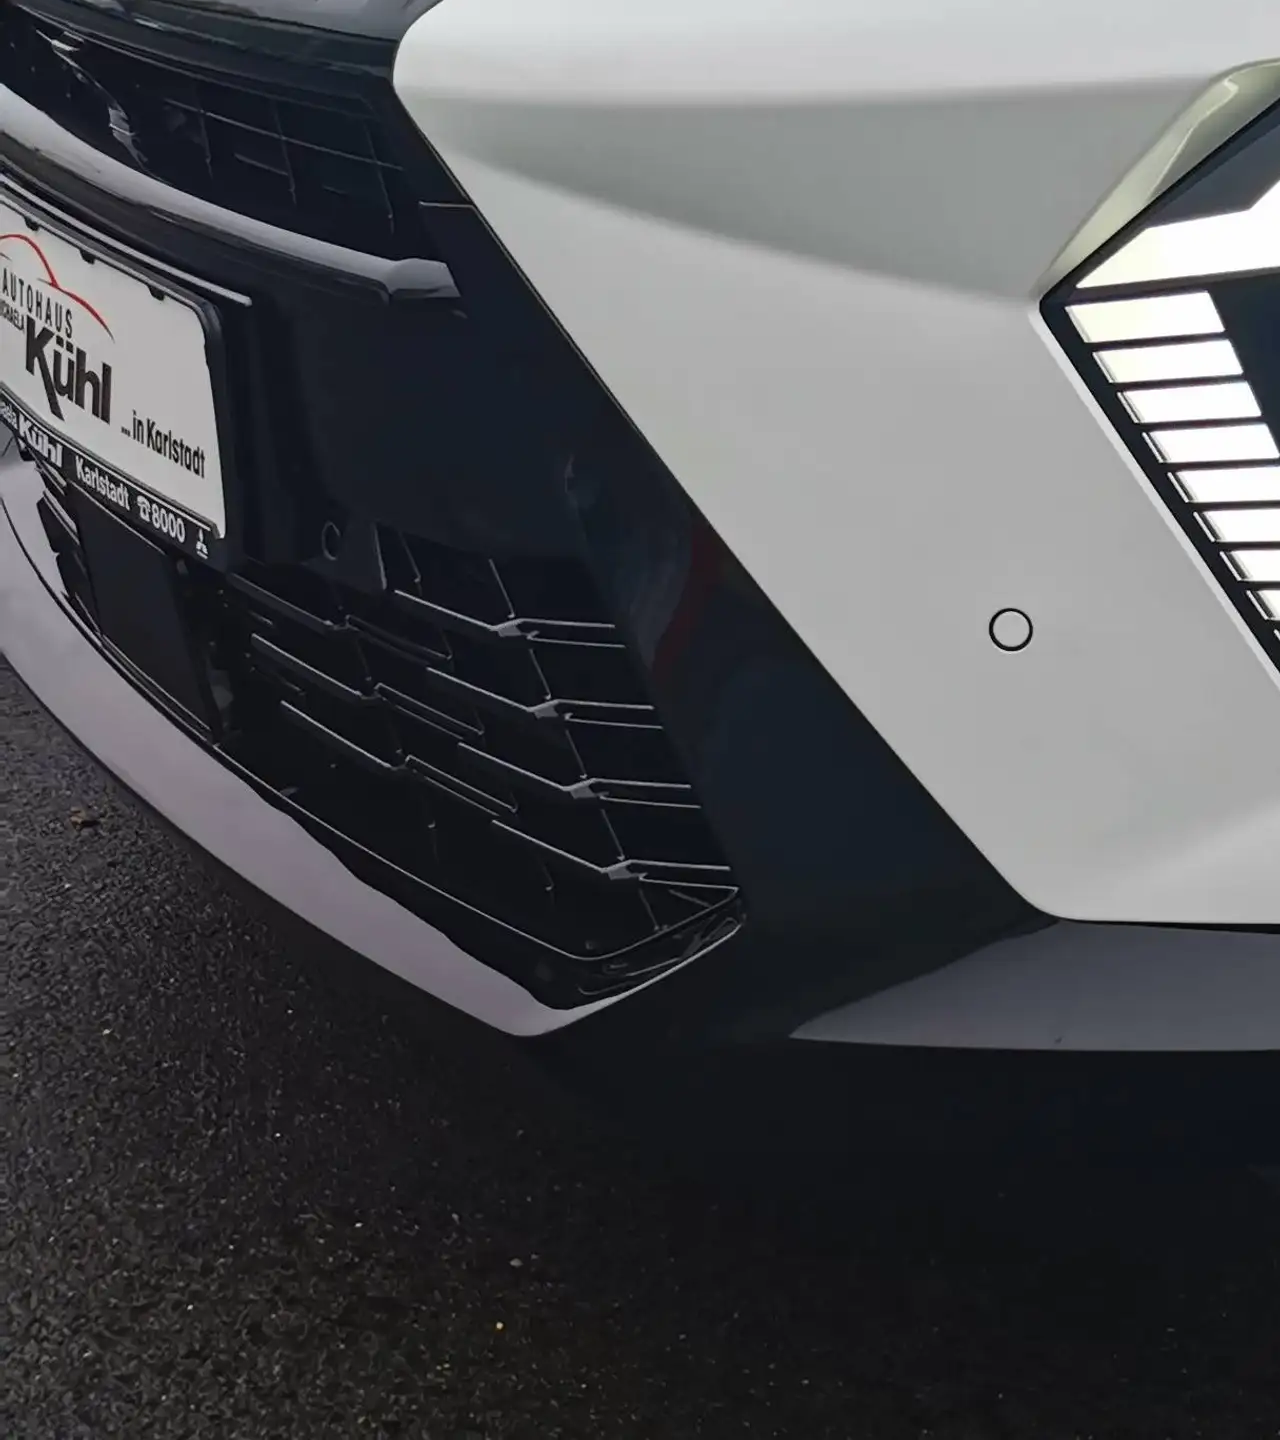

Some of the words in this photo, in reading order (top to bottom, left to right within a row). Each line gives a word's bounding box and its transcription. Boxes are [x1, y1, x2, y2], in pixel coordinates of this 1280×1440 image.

[2, 267, 73, 339] AUTOHAUS
[26, 314, 112, 426] Kühl
[146, 417, 206, 479] Karlstadt
[75, 455, 131, 512] Karlstadt
[151, 502, 186, 543] 8000
